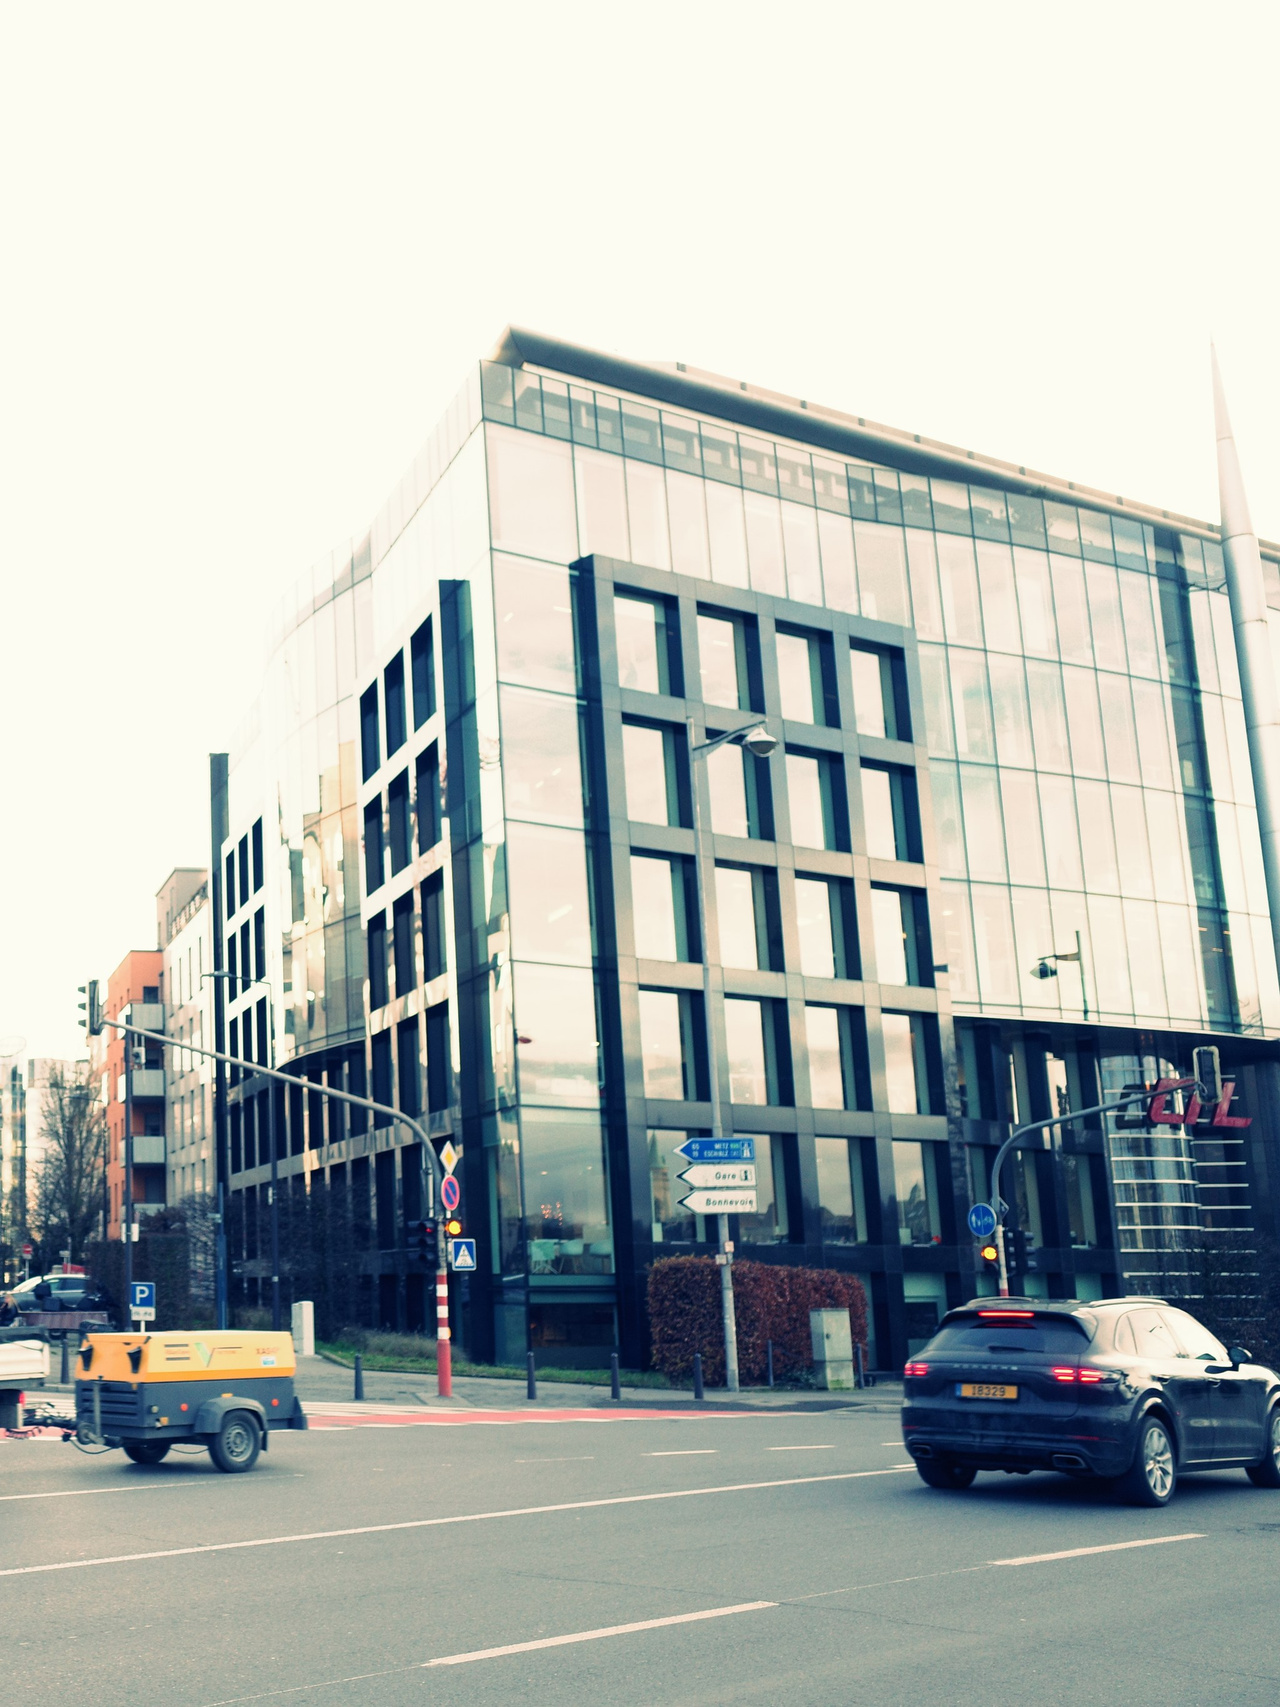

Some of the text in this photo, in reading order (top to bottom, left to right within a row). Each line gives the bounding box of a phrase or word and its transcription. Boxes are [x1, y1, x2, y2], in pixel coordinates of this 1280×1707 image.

[714, 1171, 737, 1181] Gare
[705, 1197, 754, 1208] Bonnevoie
[135, 1285, 150, 1305] P
[971, 1385, 1007, 1397] 18329
